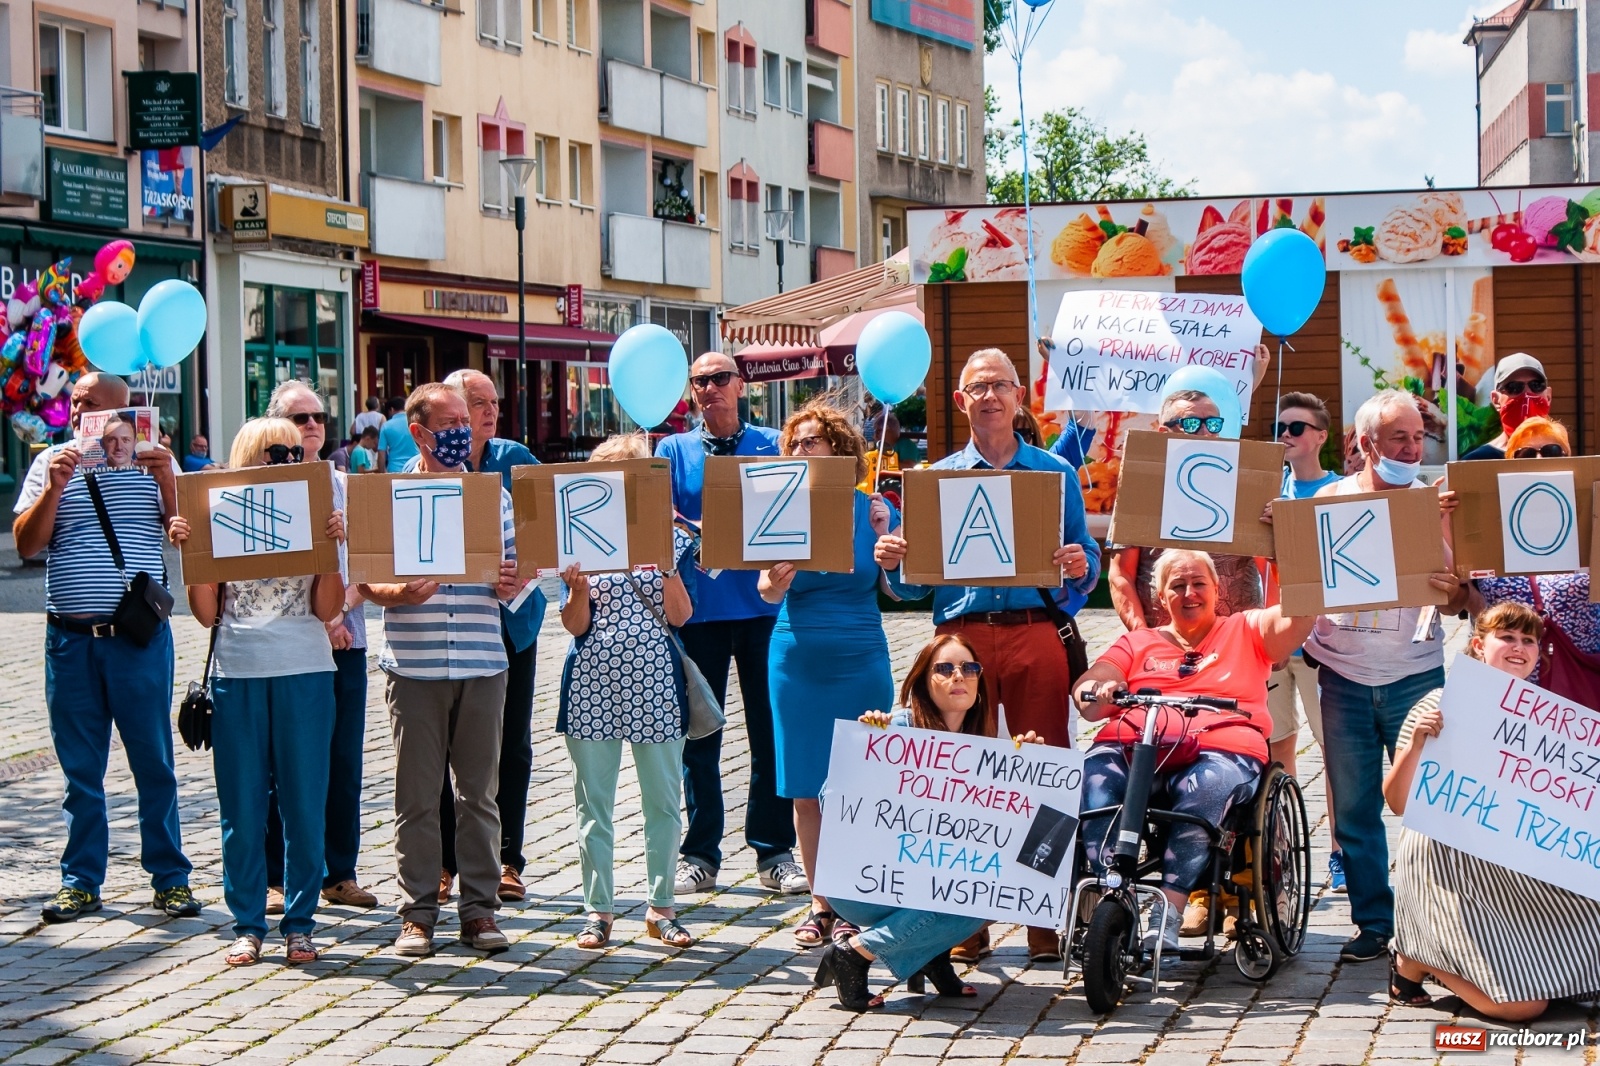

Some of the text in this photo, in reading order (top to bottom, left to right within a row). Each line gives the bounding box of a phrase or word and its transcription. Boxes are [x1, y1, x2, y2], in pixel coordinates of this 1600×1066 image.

[1189, 299, 1245, 317] DAMA
[1073, 315, 1089, 330] W
[1170, 319, 1231, 339] STAŁA
[746, 361, 782, 379] Gelateria
[782, 358, 800, 372] Ciao
[1066, 337, 1256, 371] O PRAWACH KOBIET
[1500, 679, 1600, 748] LEKARST
[1493, 718, 1527, 751] NA
[976, 749, 1081, 791] MARNEGO
[840, 794, 863, 824] W
[1415, 760, 1500, 832] RAFAŁ
[897, 834, 1002, 877] RAFAŁA
